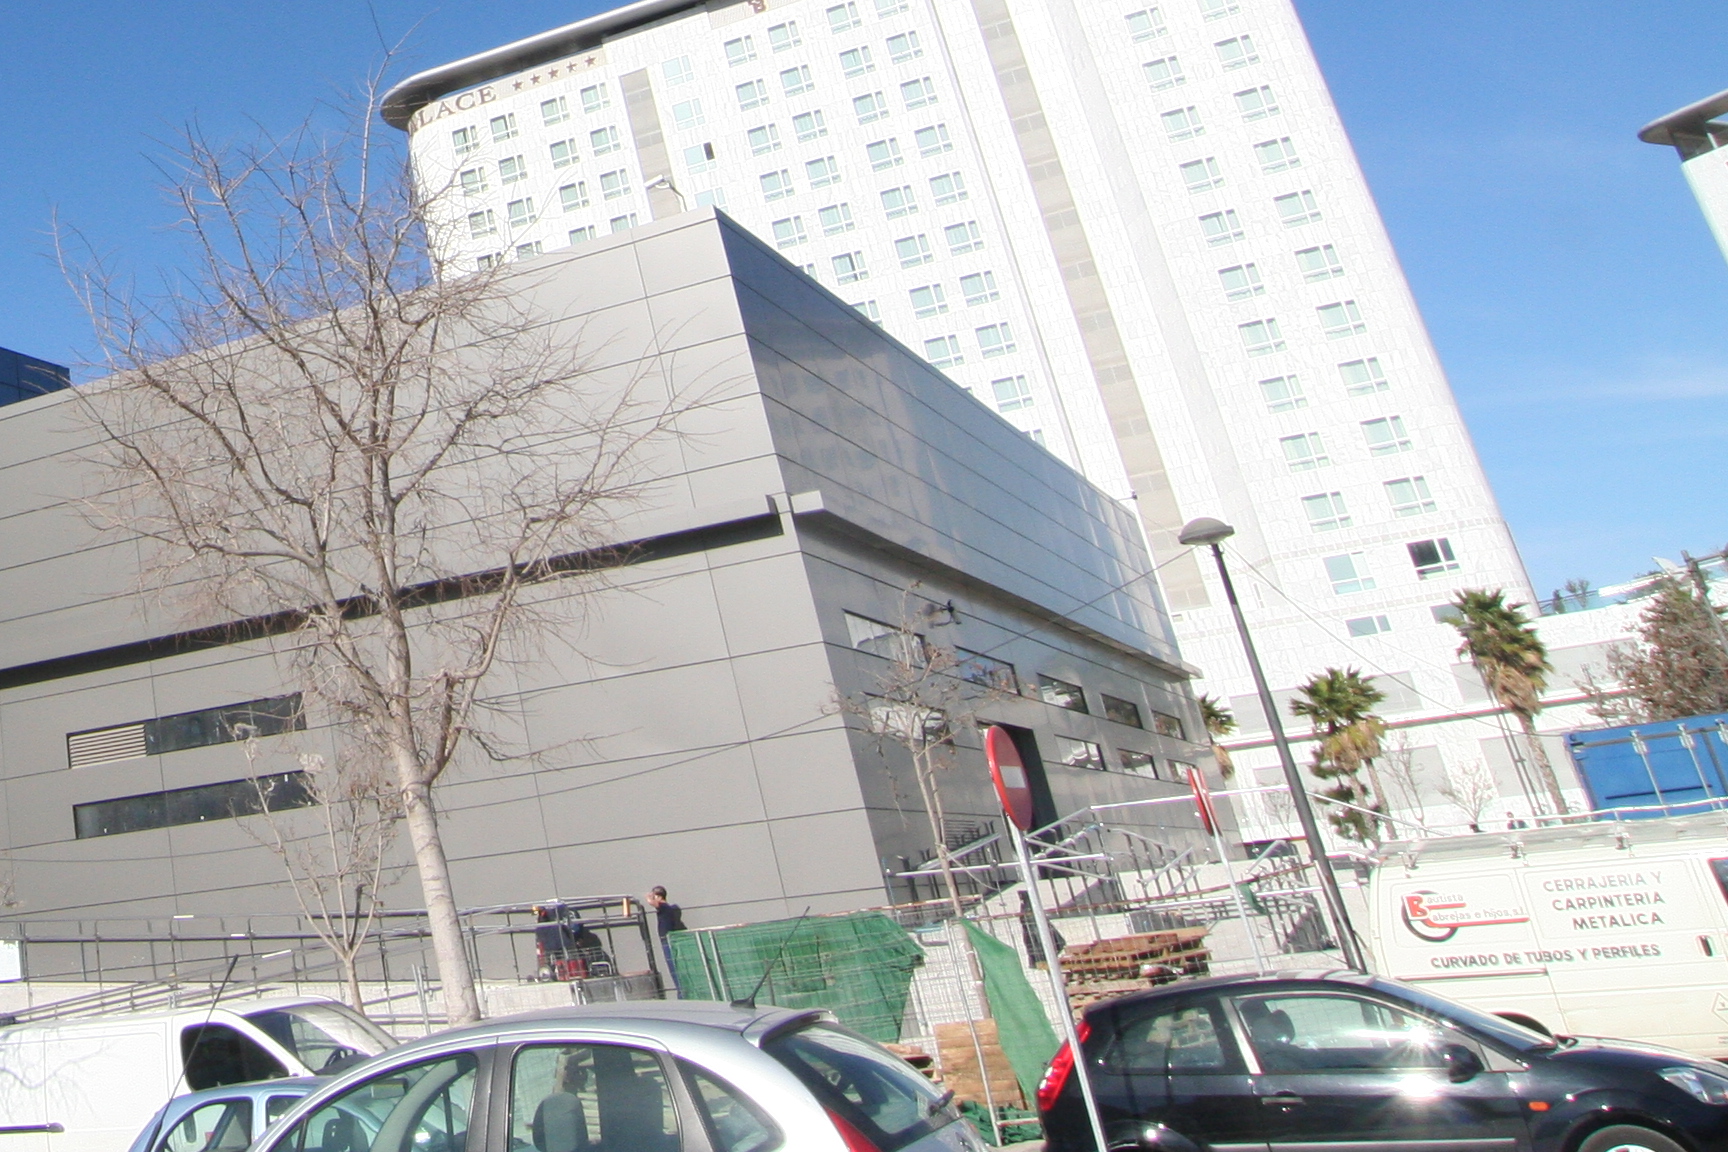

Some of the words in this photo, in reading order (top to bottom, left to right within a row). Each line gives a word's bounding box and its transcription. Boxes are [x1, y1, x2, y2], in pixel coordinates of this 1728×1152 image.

[409, 85, 497, 135] ALACE
[1543, 873, 1647, 892] CERRAJERIA
[1650, 871, 1662, 884] Y
[1552, 891, 1665, 911] CARPINTERIA
[1572, 912, 1665, 930] METALICA
[1430, 953, 1499, 968] CURVADO
[1503, 952, 1521, 964] DE
[1524, 950, 1574, 964] TUBOS
[1577, 948, 1589, 960] Y
[1591, 944, 1661, 960] PERFILES
